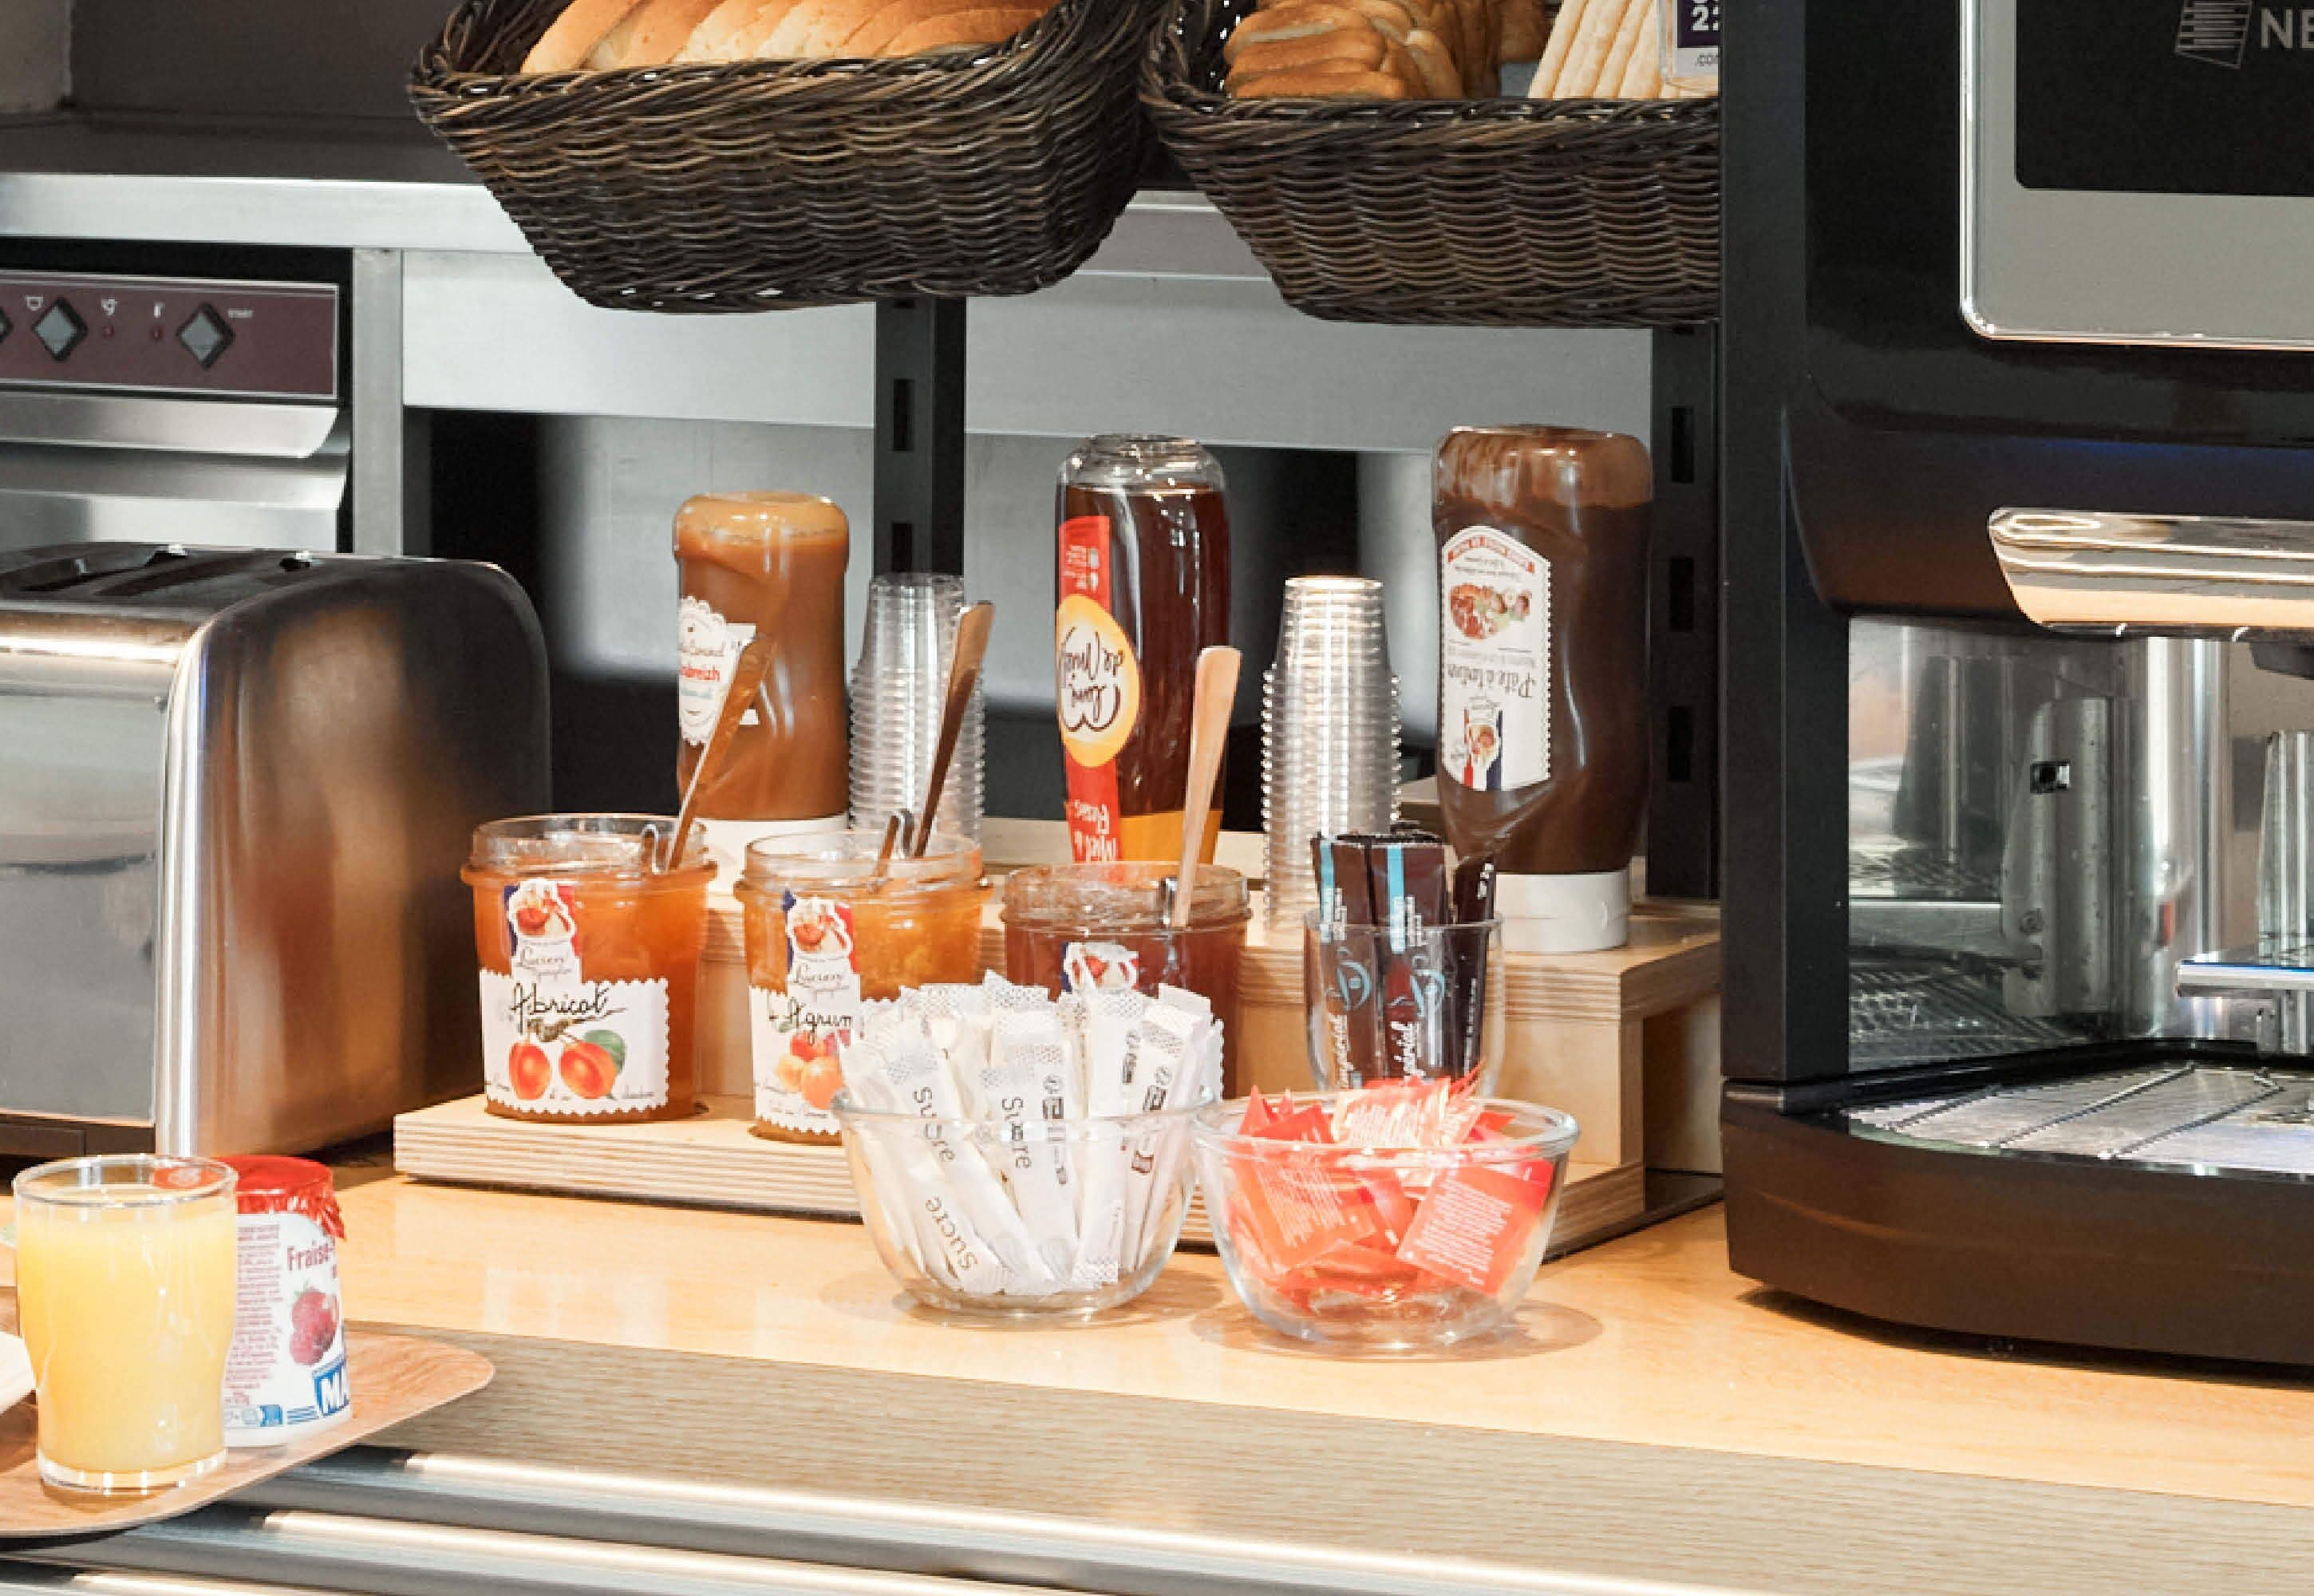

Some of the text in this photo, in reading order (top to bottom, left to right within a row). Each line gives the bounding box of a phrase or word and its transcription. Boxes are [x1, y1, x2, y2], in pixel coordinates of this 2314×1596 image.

[2261, 8, 2314, 49] NE
[511, 982, 611, 1035] Abricot
[914, 1085, 956, 1163] Sucre
[1001, 1096, 1032, 1170] Sucre
[925, 1195, 979, 1271] Sucre
